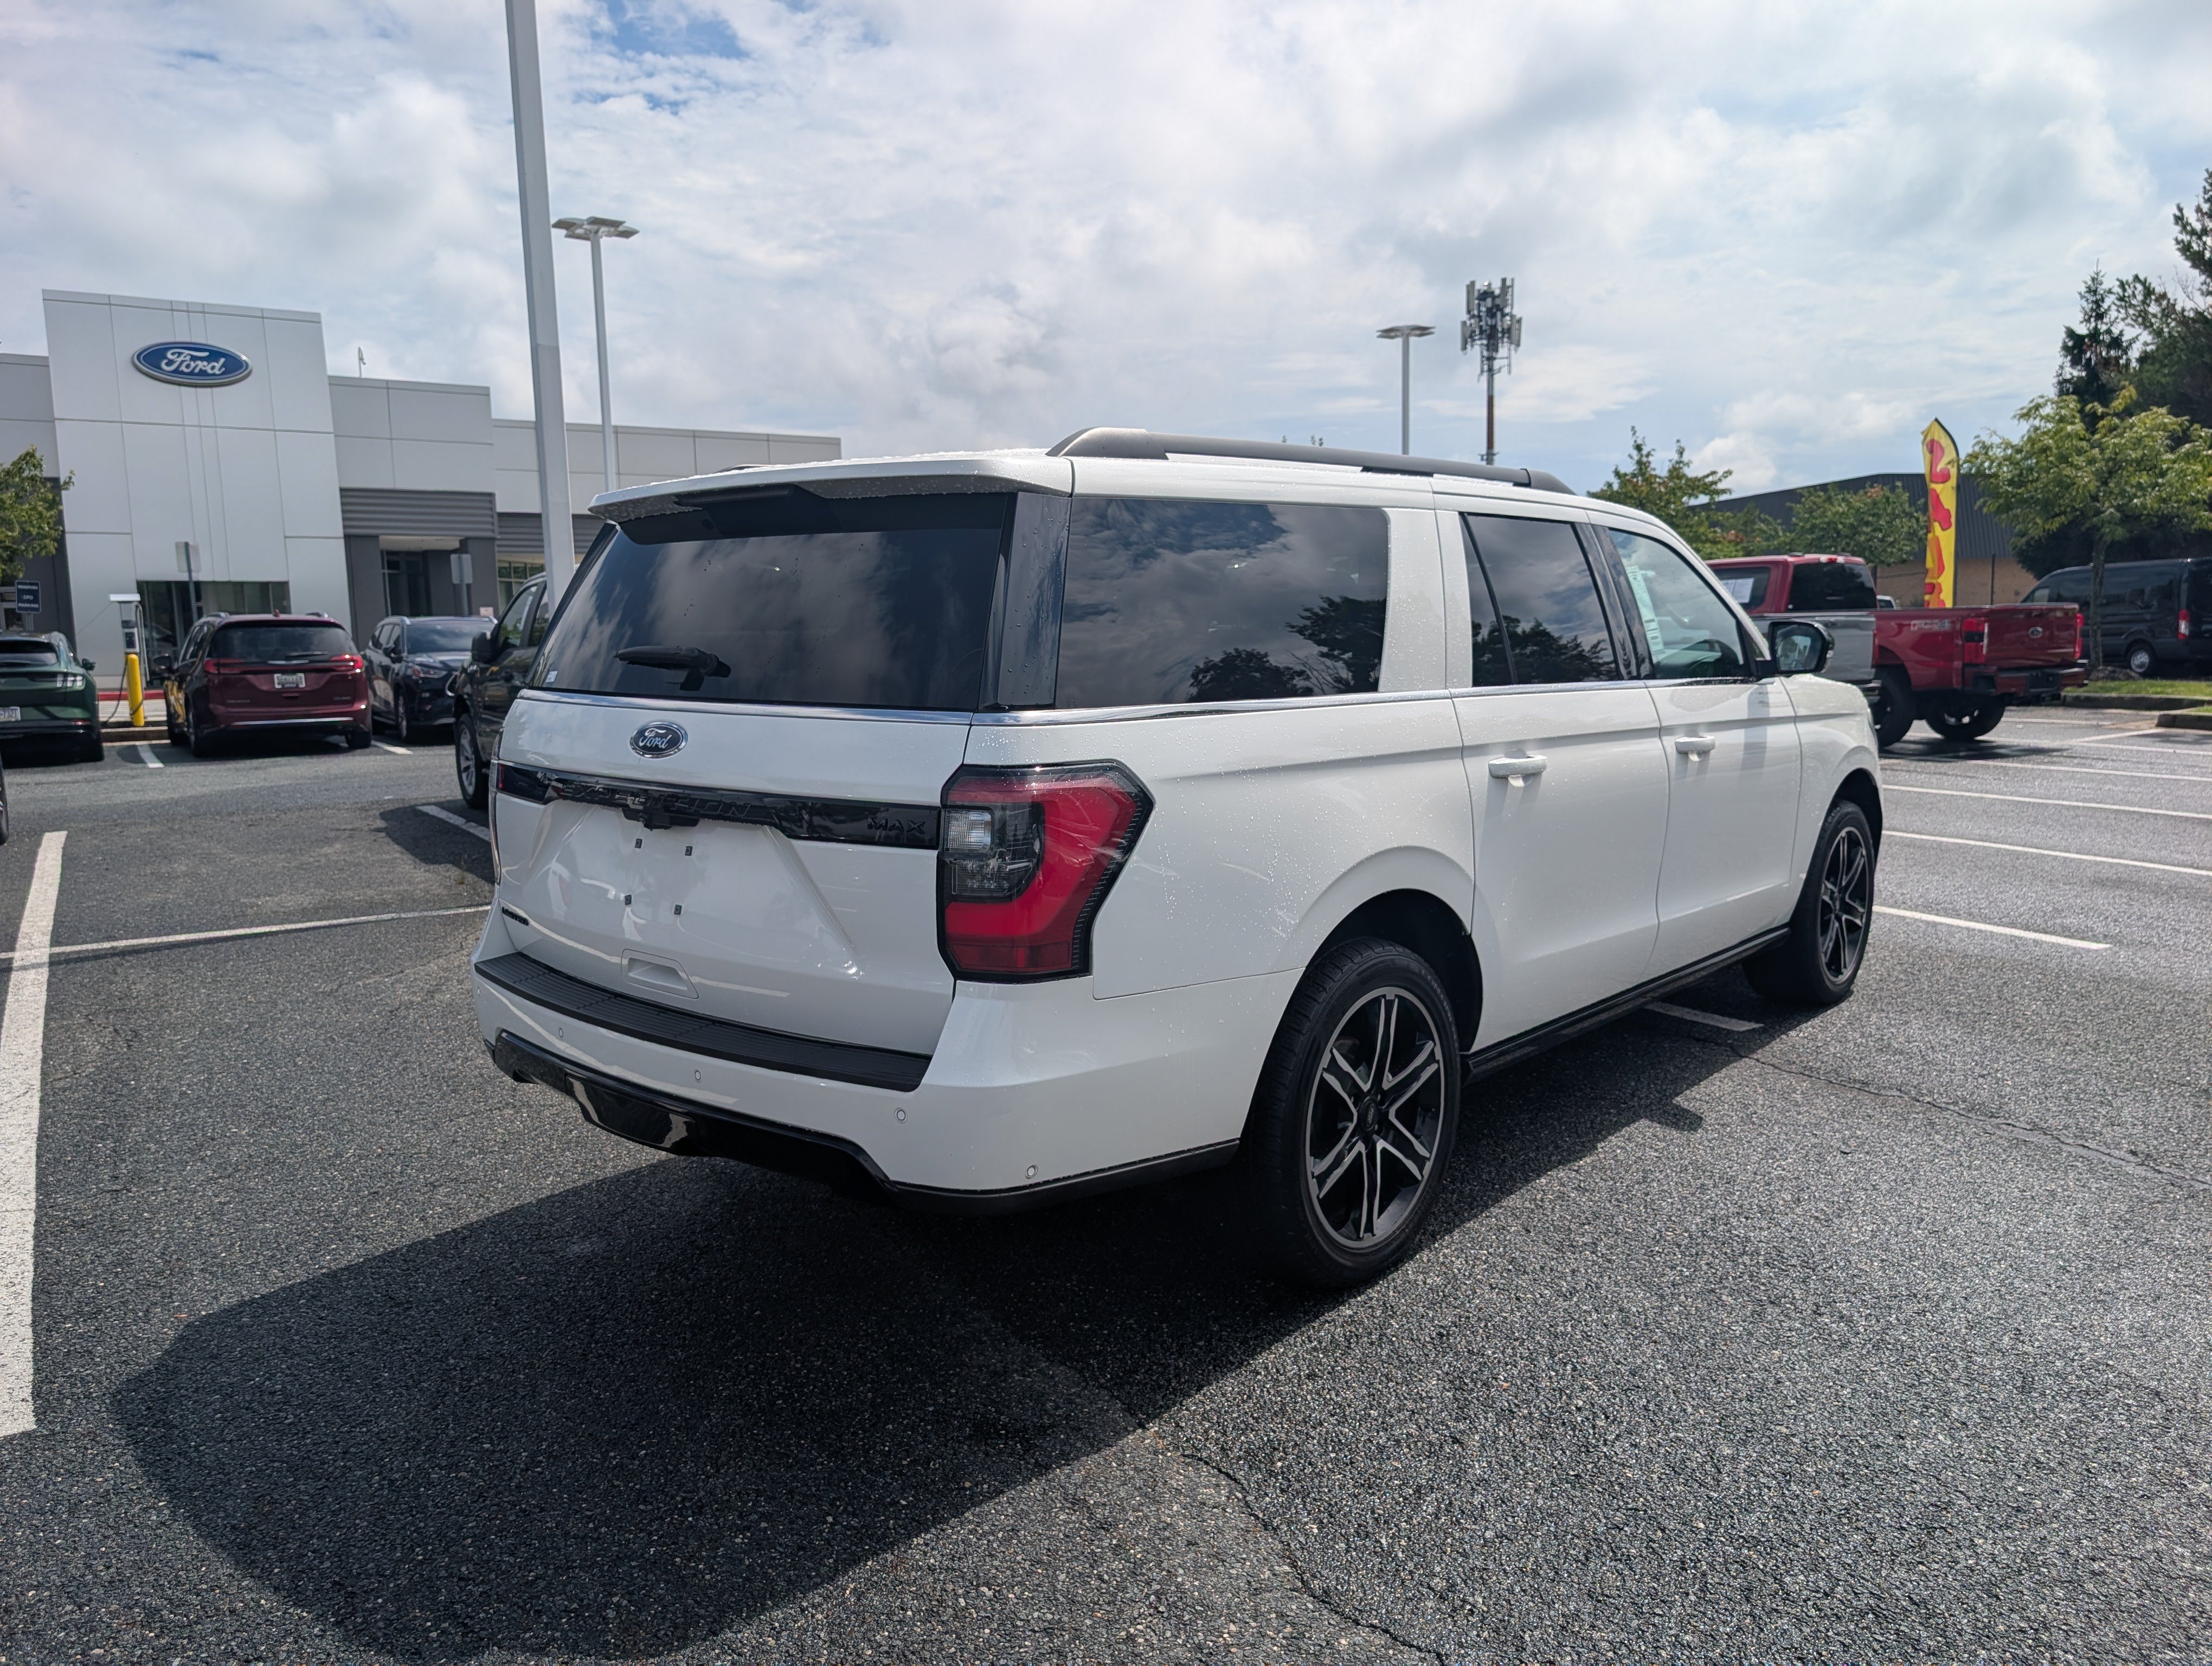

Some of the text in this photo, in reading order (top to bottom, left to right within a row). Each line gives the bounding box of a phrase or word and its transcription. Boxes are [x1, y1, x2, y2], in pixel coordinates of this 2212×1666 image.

[161, 348, 226, 374] Ford
[639, 727, 672, 748] Ford
[562, 781, 752, 817] EXPEDITION
[867, 816, 926, 835] MAX
